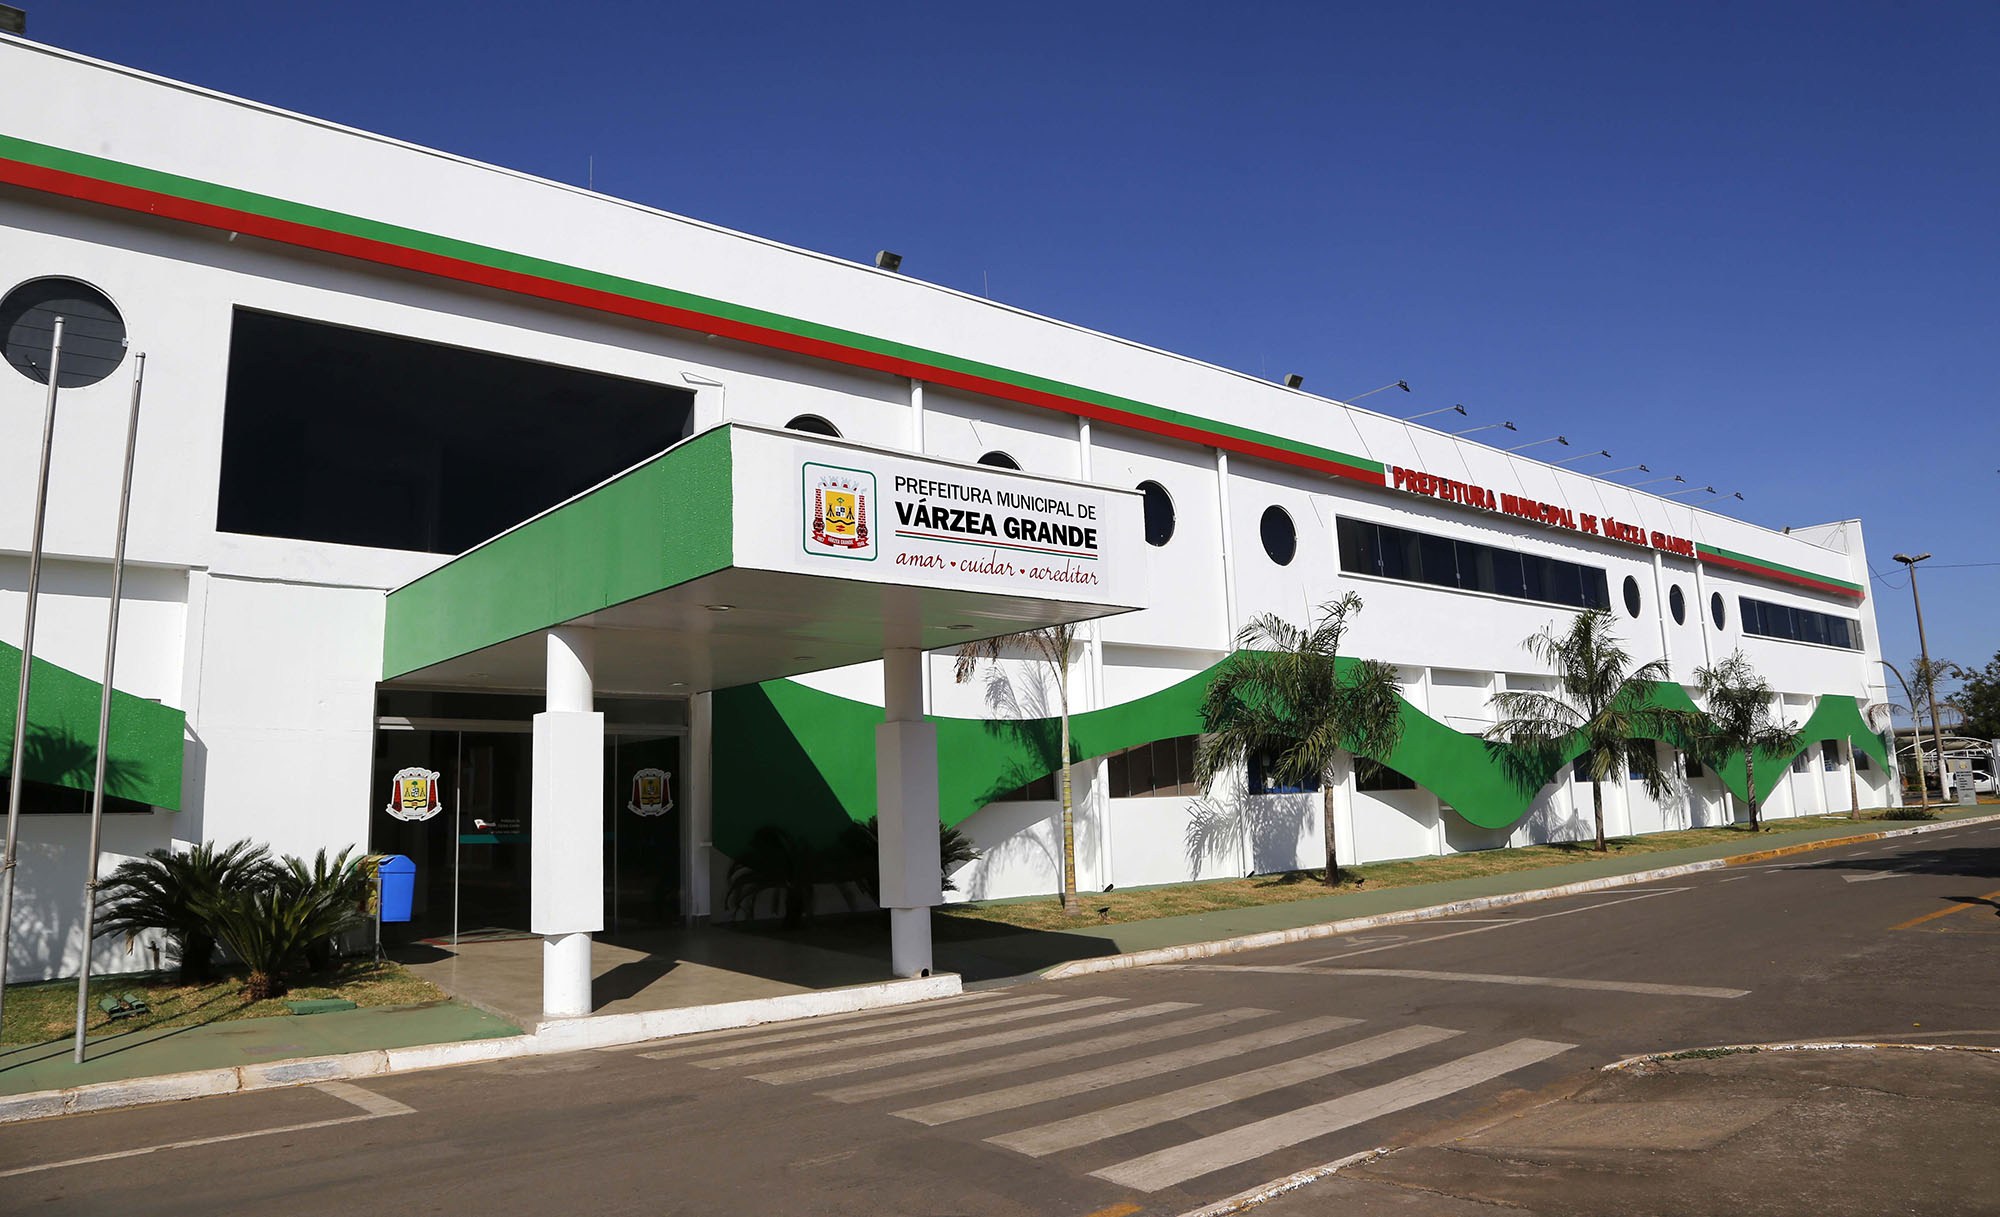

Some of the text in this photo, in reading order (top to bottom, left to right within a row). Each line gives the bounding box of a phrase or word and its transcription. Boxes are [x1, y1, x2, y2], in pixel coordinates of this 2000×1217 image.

[895, 475, 1097, 520] PREFEITURA MUNICIPAL DE
[1393, 466, 1695, 557] PREFEITURA MUNICIPAL DE VÁRZEA GRANDE
[895, 498, 1098, 550] VÁRZEA GRANDE
[895, 549, 1100, 586] amar cuidar acreditar
